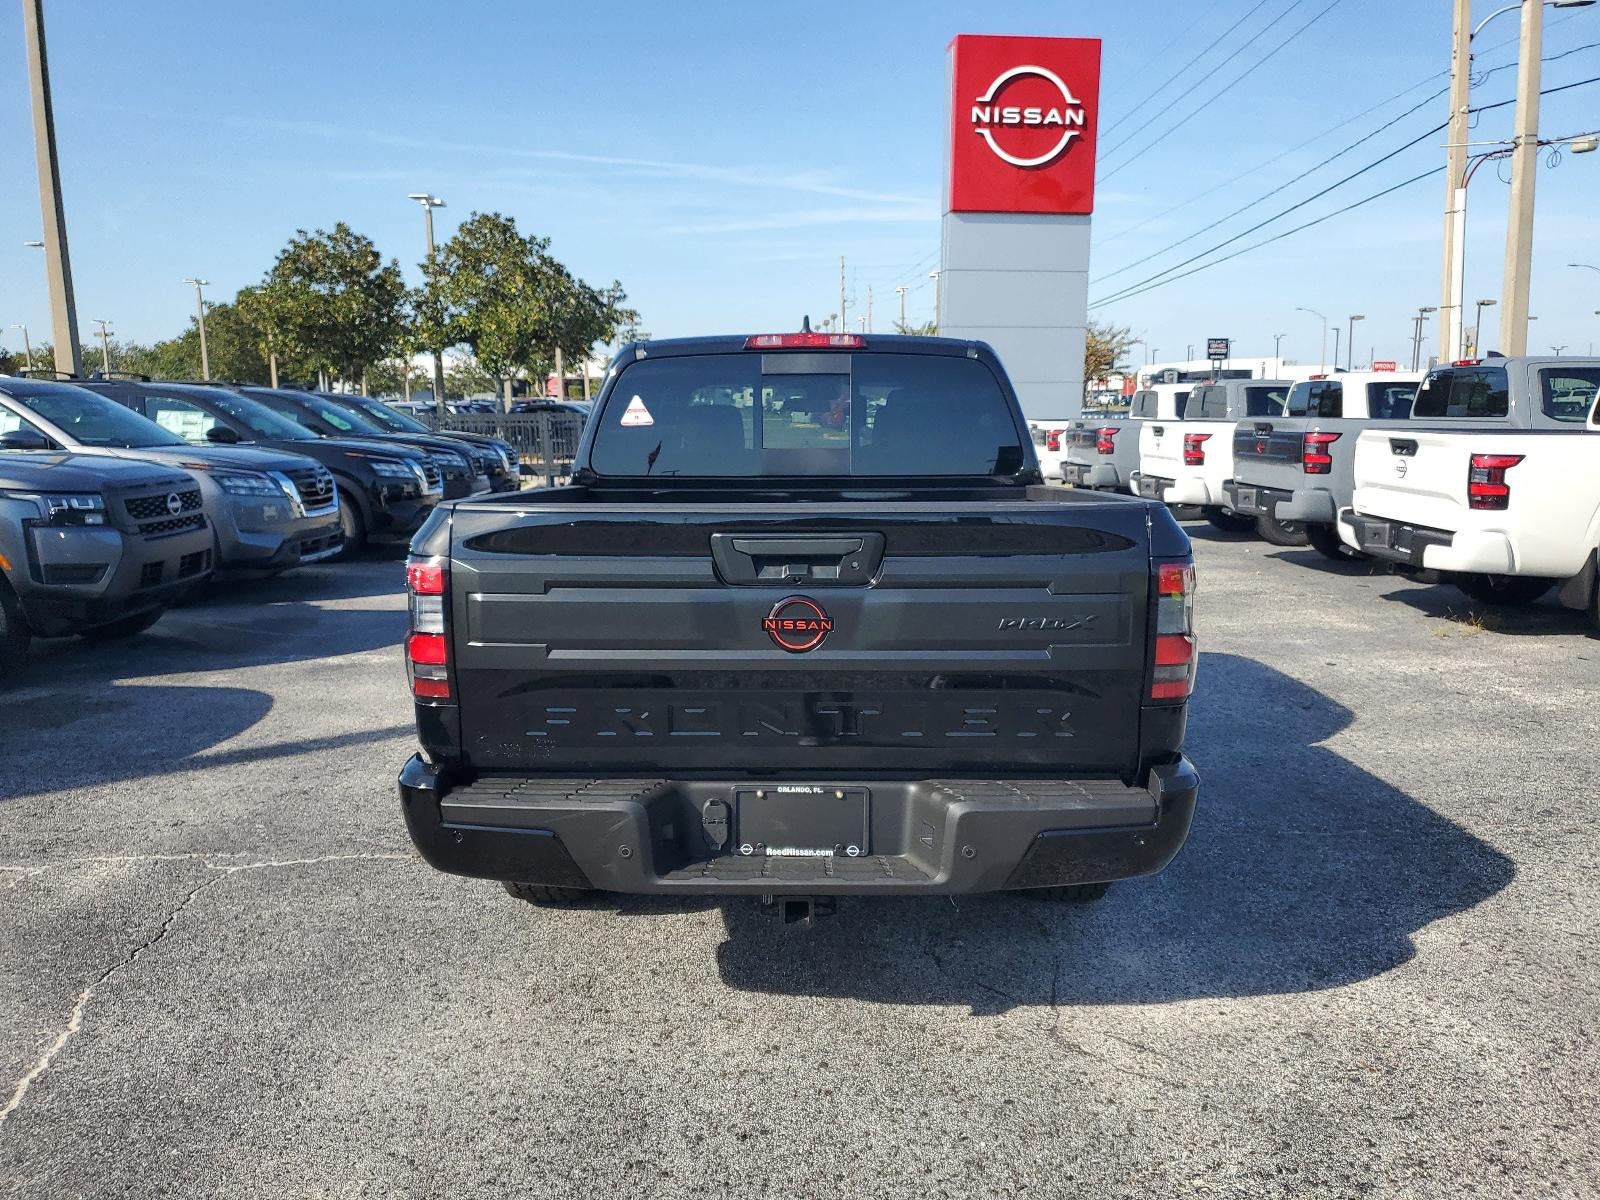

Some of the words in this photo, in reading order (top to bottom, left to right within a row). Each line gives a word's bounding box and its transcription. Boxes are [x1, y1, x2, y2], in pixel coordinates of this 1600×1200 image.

[971, 106, 1085, 125] NISSAN
[764, 620, 832, 630] NISSAN
[525, 704, 1076, 737] FRONTIER
[777, 786, 812, 794] ORLANDO,
[766, 847, 834, 857] ReedNissan.com
